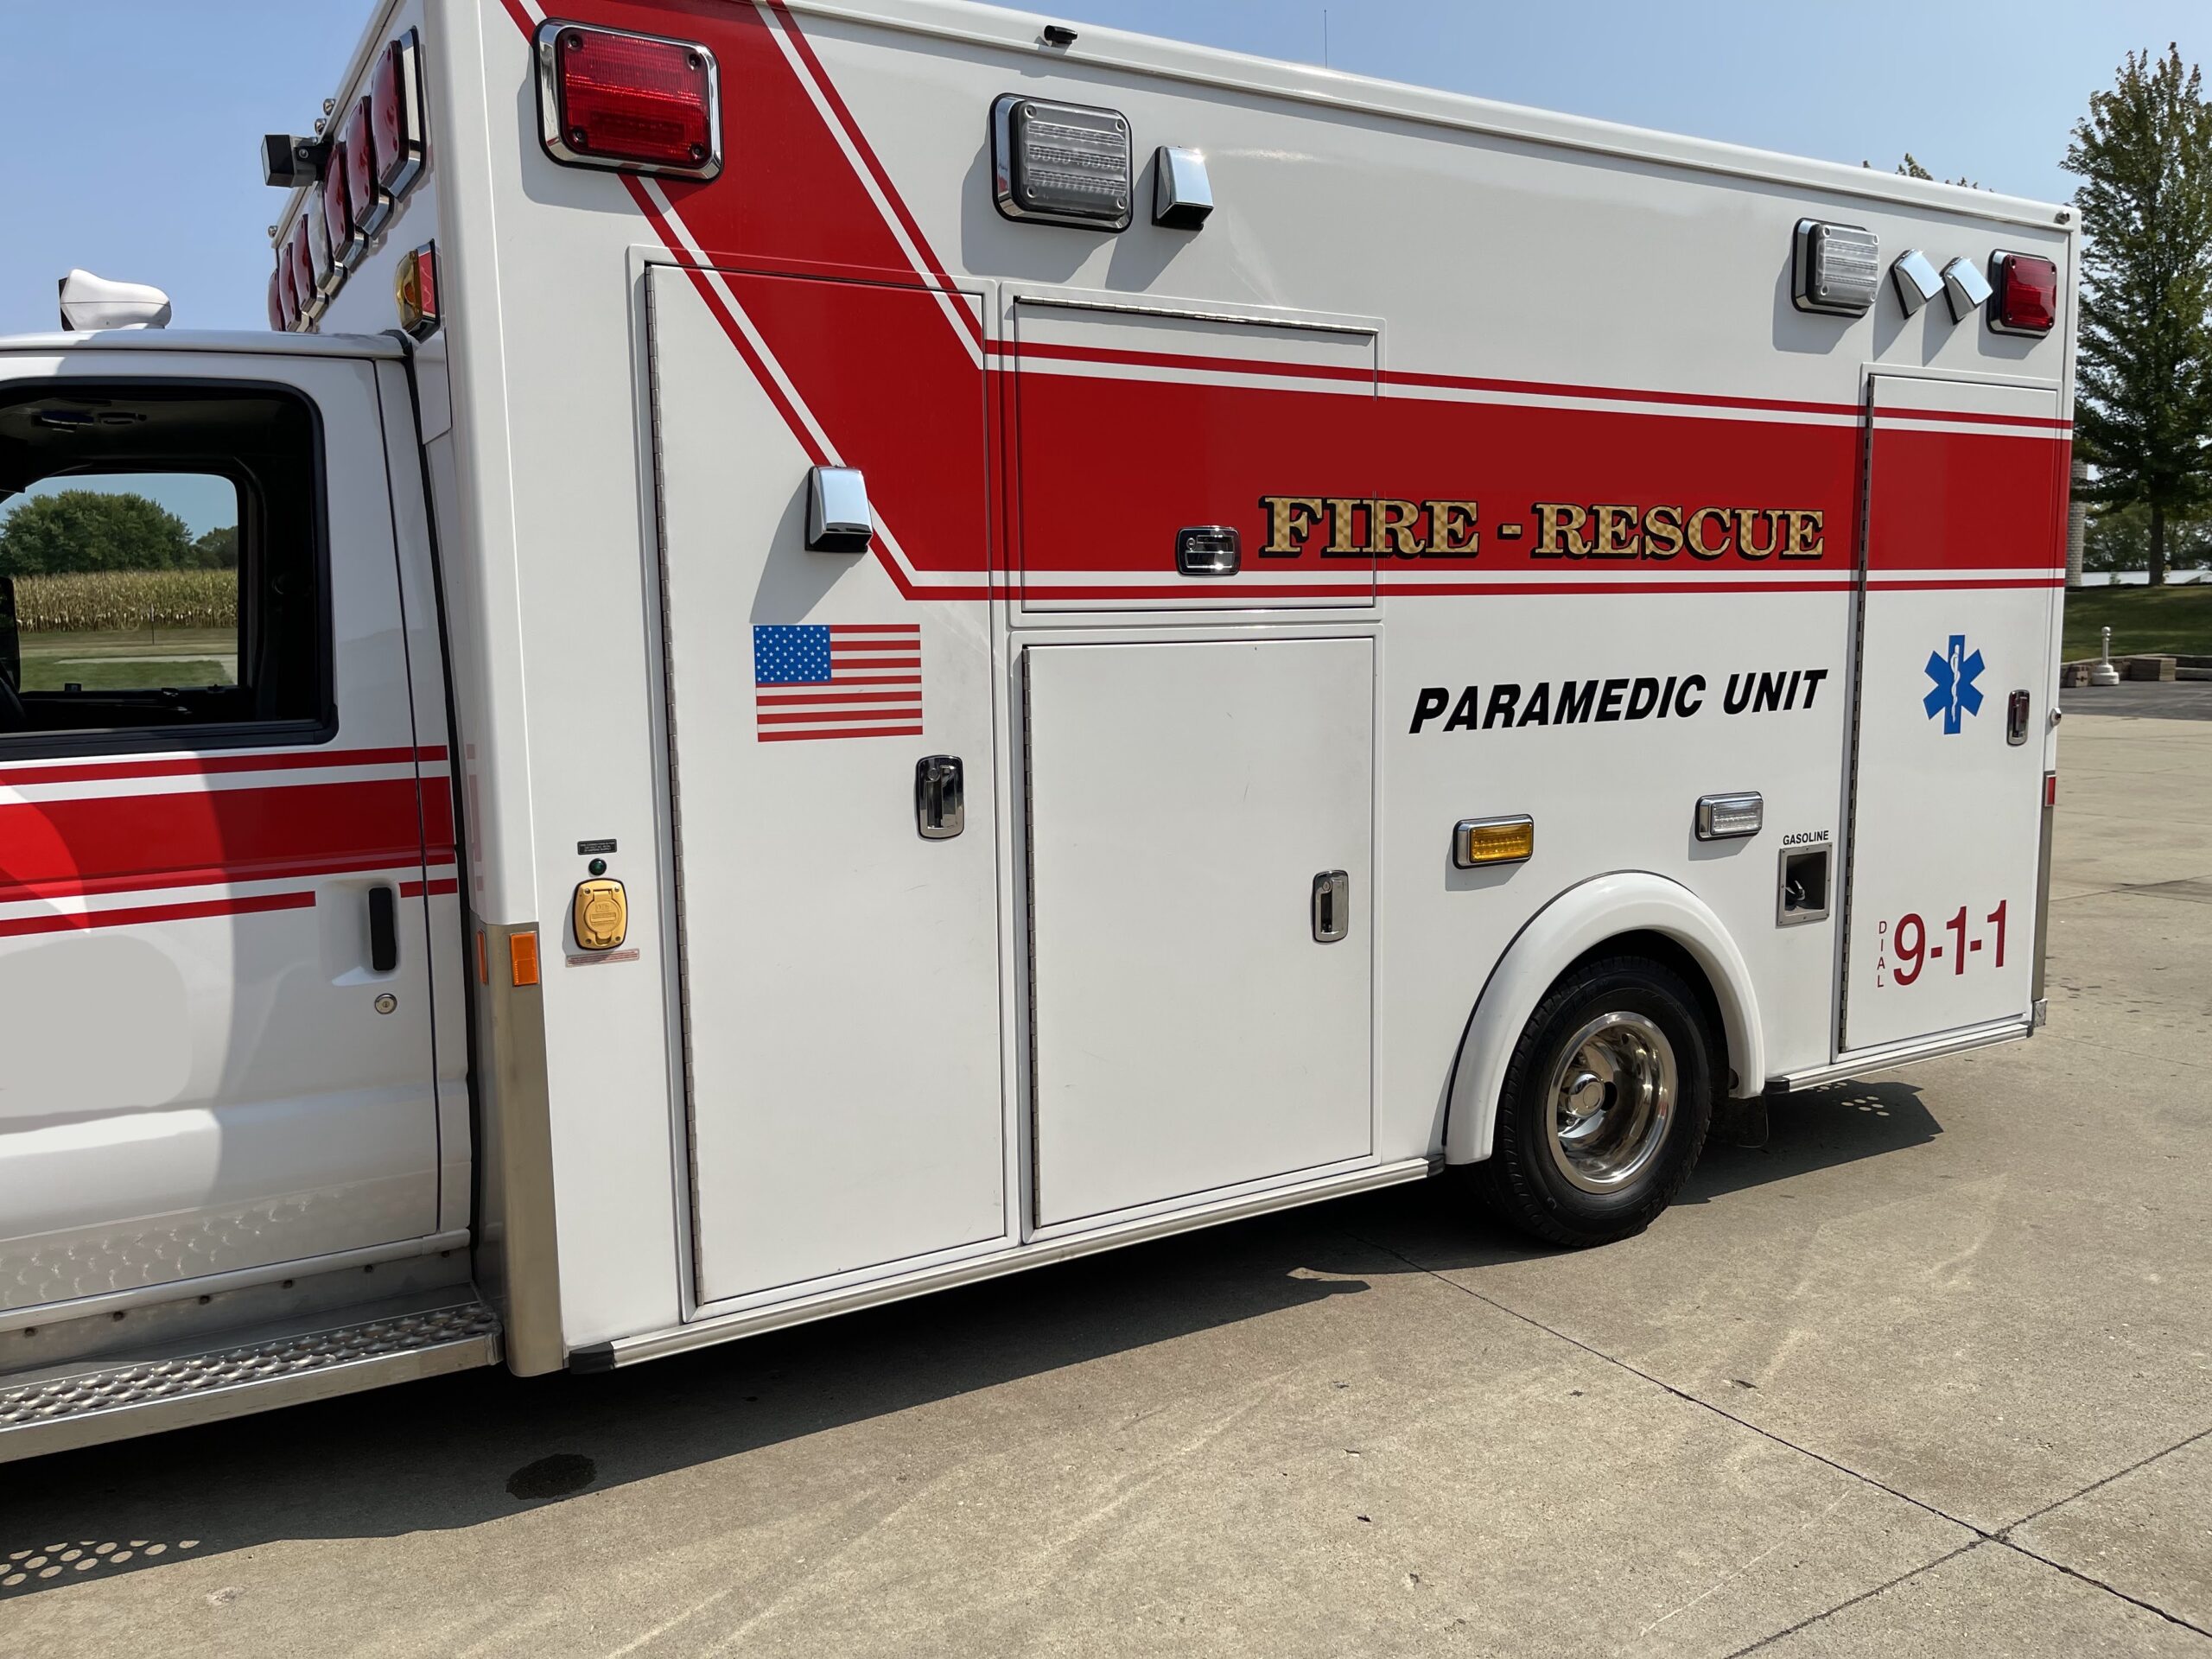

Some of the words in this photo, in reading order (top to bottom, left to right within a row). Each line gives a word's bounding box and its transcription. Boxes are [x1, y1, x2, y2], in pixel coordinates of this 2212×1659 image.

[1259, 495, 1480, 558] FIRE
[1531, 501, 1825, 561] RESCUE
[1408, 674, 1707, 734] PARAMEDIC
[1723, 669, 1828, 713] UNIT
[1783, 830, 1829, 846] GASOLINE
[1877, 921, 1887, 988] DIAL
[1893, 899, 2007, 986] 9-1-1
